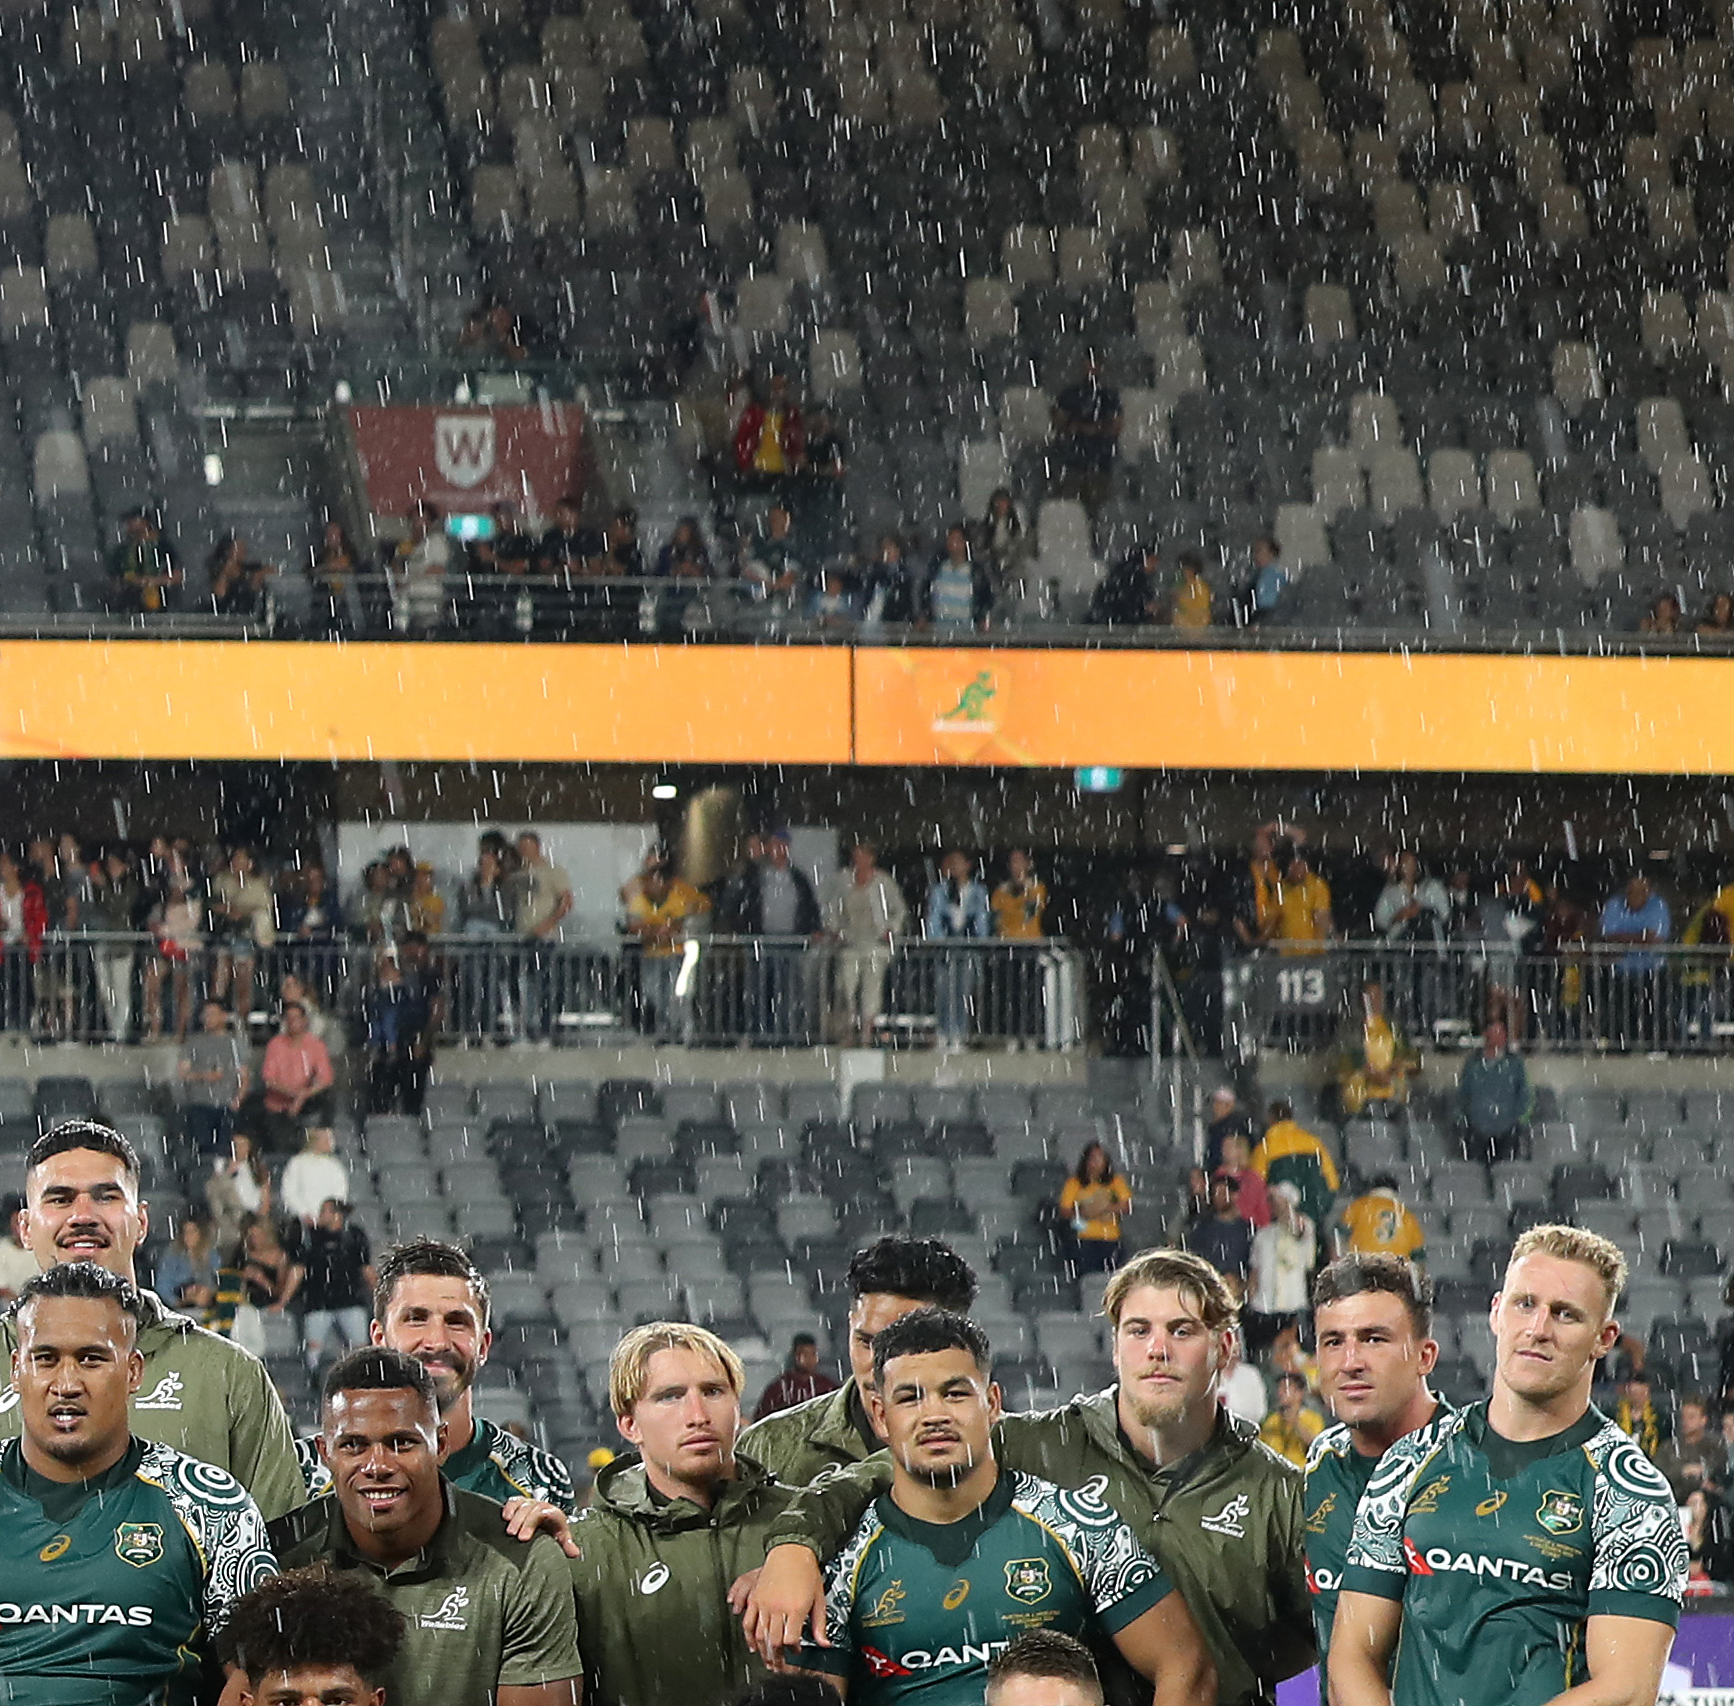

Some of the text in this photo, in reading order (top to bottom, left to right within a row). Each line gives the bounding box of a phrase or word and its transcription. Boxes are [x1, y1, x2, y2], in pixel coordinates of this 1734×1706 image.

[444, 427, 486, 467] W
[1276, 968, 1325, 1004] 113
[1425, 1547, 1573, 1591] QANTAS
[900, 1641, 1010, 1670] QANT
